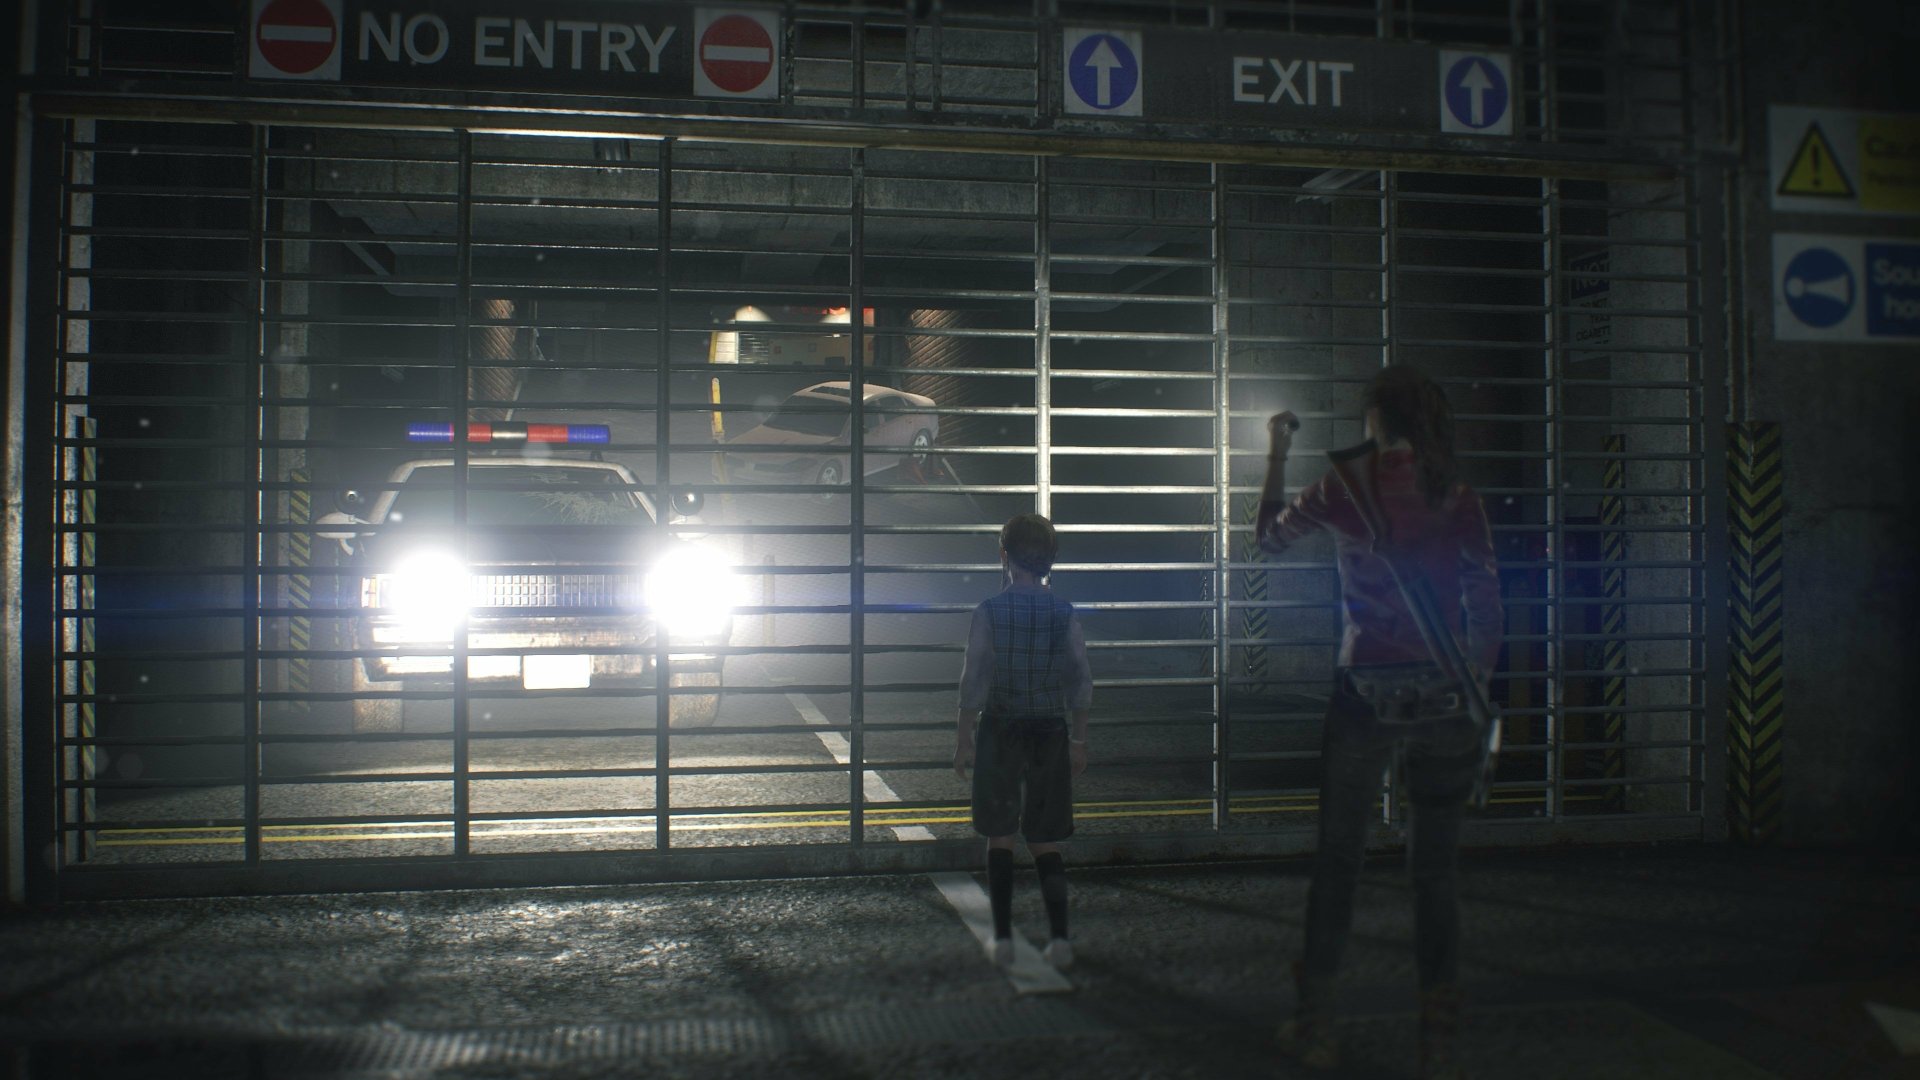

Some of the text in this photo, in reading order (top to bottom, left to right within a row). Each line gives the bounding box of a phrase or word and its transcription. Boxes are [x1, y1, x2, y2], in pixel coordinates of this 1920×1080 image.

[358, 11, 677, 73] NO ENTRY
[1233, 56, 1354, 107] EXIT
